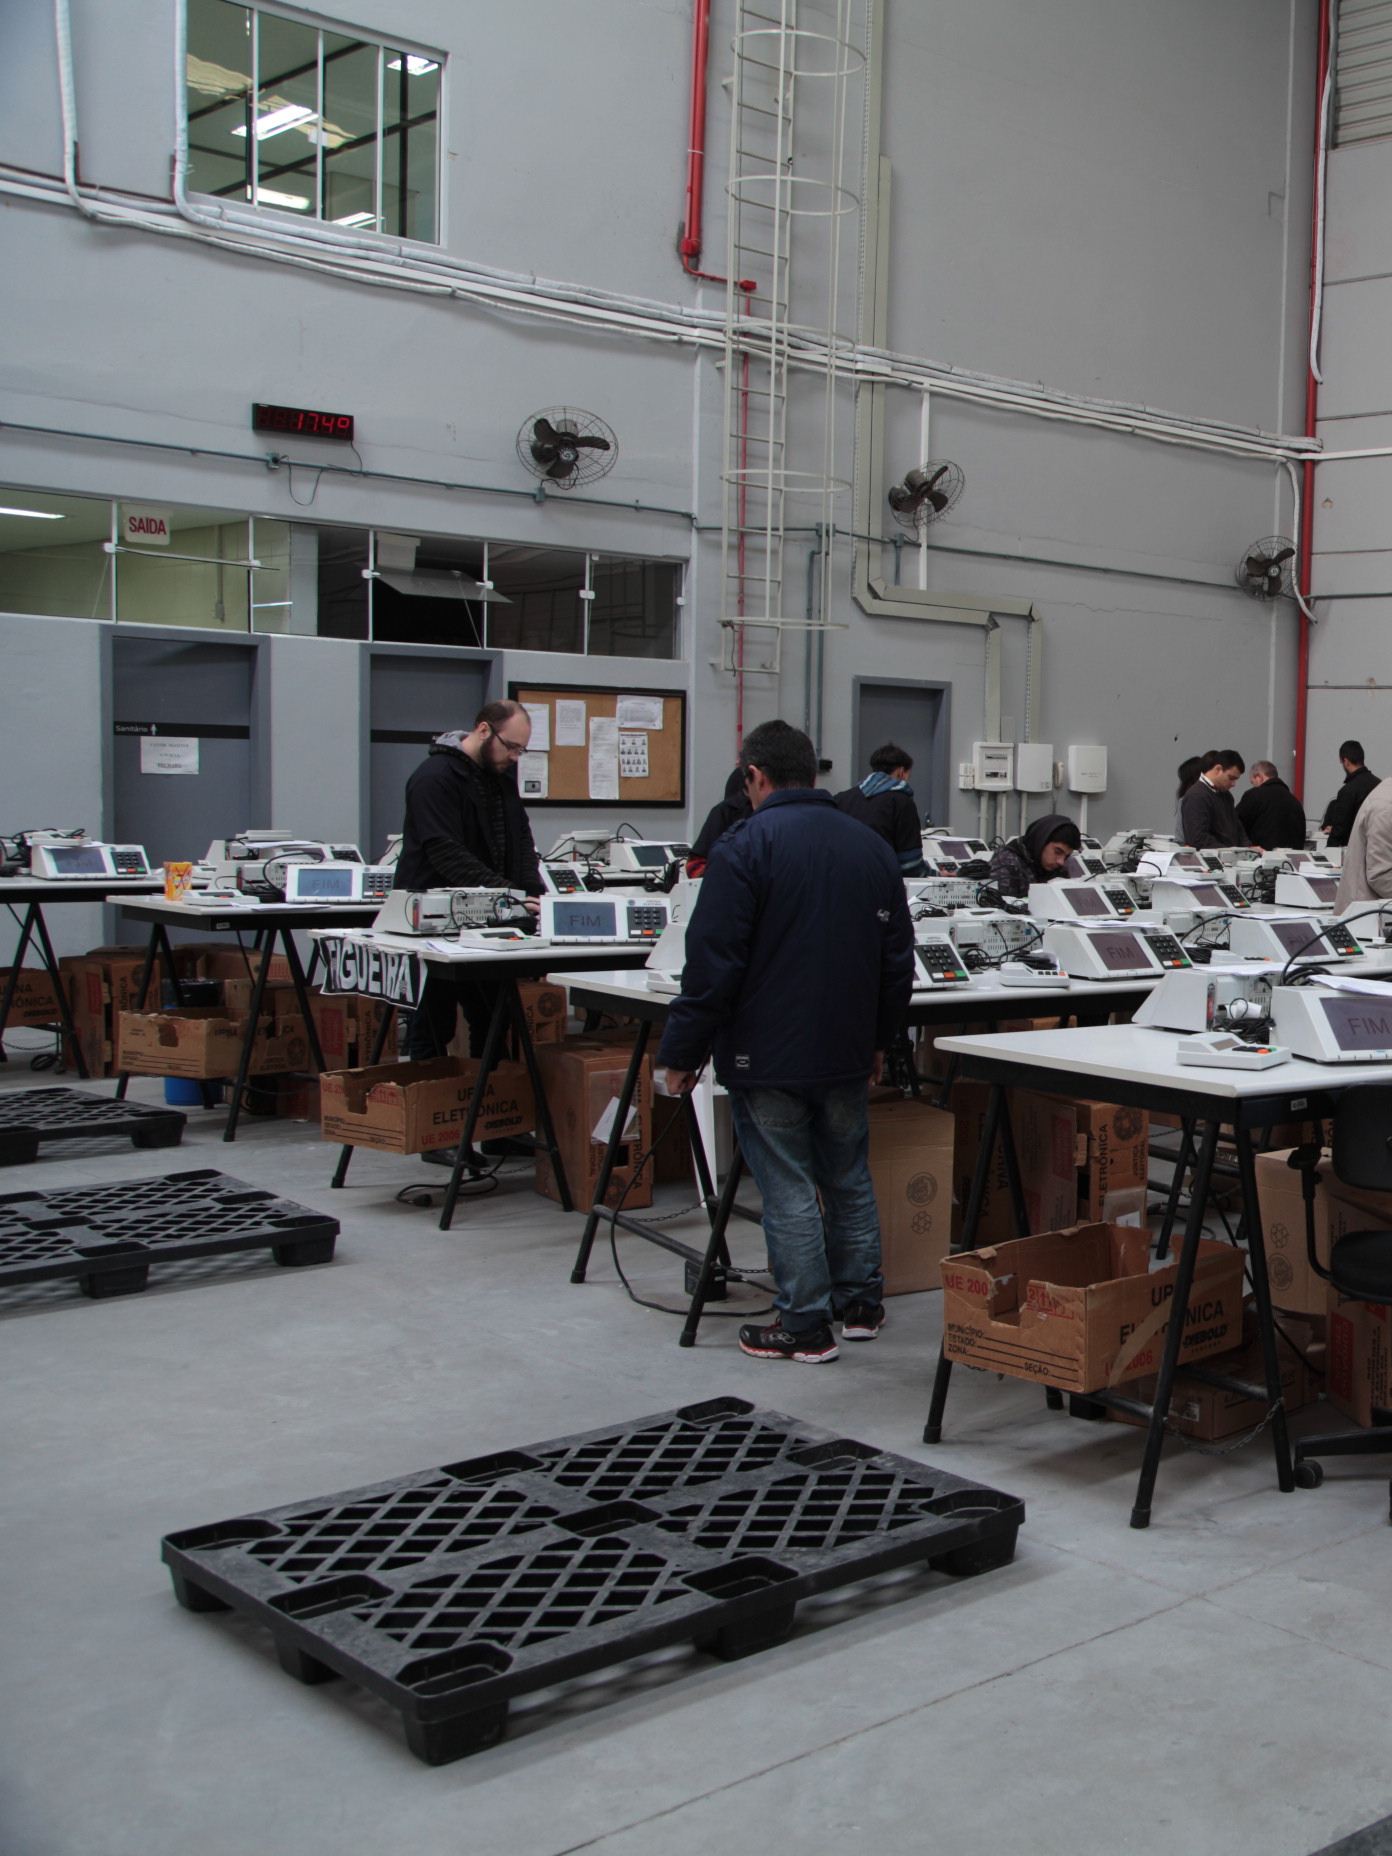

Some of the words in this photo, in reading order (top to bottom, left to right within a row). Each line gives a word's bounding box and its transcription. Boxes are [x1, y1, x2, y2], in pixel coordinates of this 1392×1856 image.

[115, 725, 148, 733] Sanitário
[570, 915, 601, 927] FIM
[1106, 946, 1135, 960] FIM
[326, 936, 414, 1003] FIGUEIRA
[1347, 1017, 1391, 1035] FIM
[945, 1275, 964, 1291] UE
[967, 1278, 988, 1296] 200
[1182, 1323, 1229, 1348] DIEBOLD
